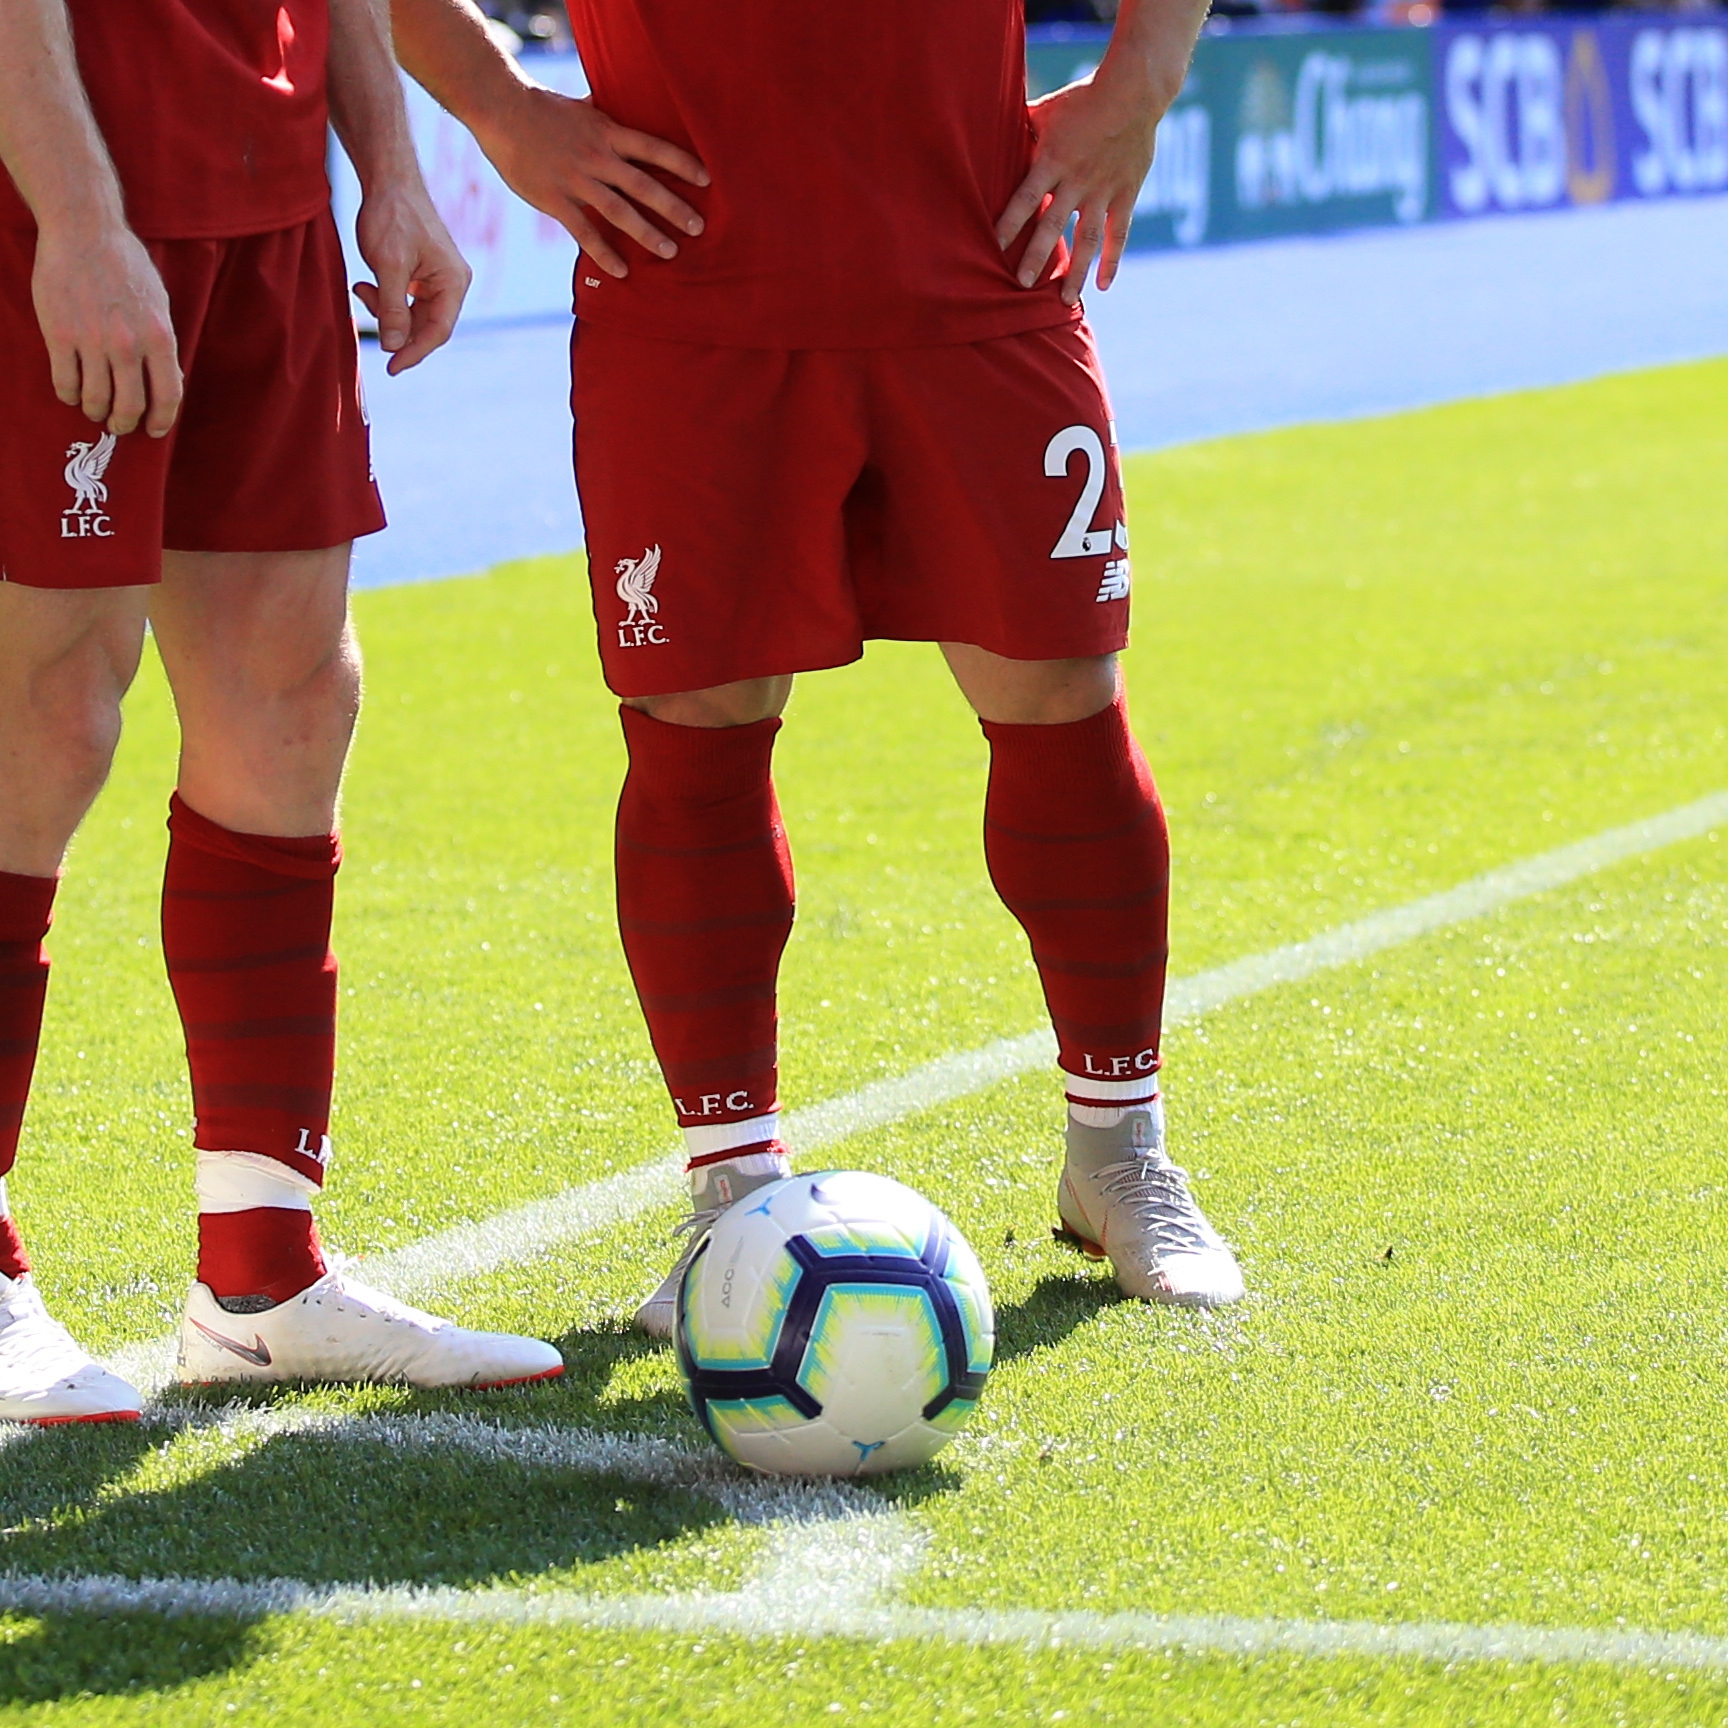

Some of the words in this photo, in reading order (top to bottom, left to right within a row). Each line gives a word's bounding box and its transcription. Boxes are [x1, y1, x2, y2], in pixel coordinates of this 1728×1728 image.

[1294, 50, 1428, 223] Chang
[1446, 32, 1565, 214] SCB
[617, 625, 670, 648] L.F.C.
[1083, 1048, 1158, 1076] L.F.C.
[674, 1090, 754, 1116] L.F.C.
